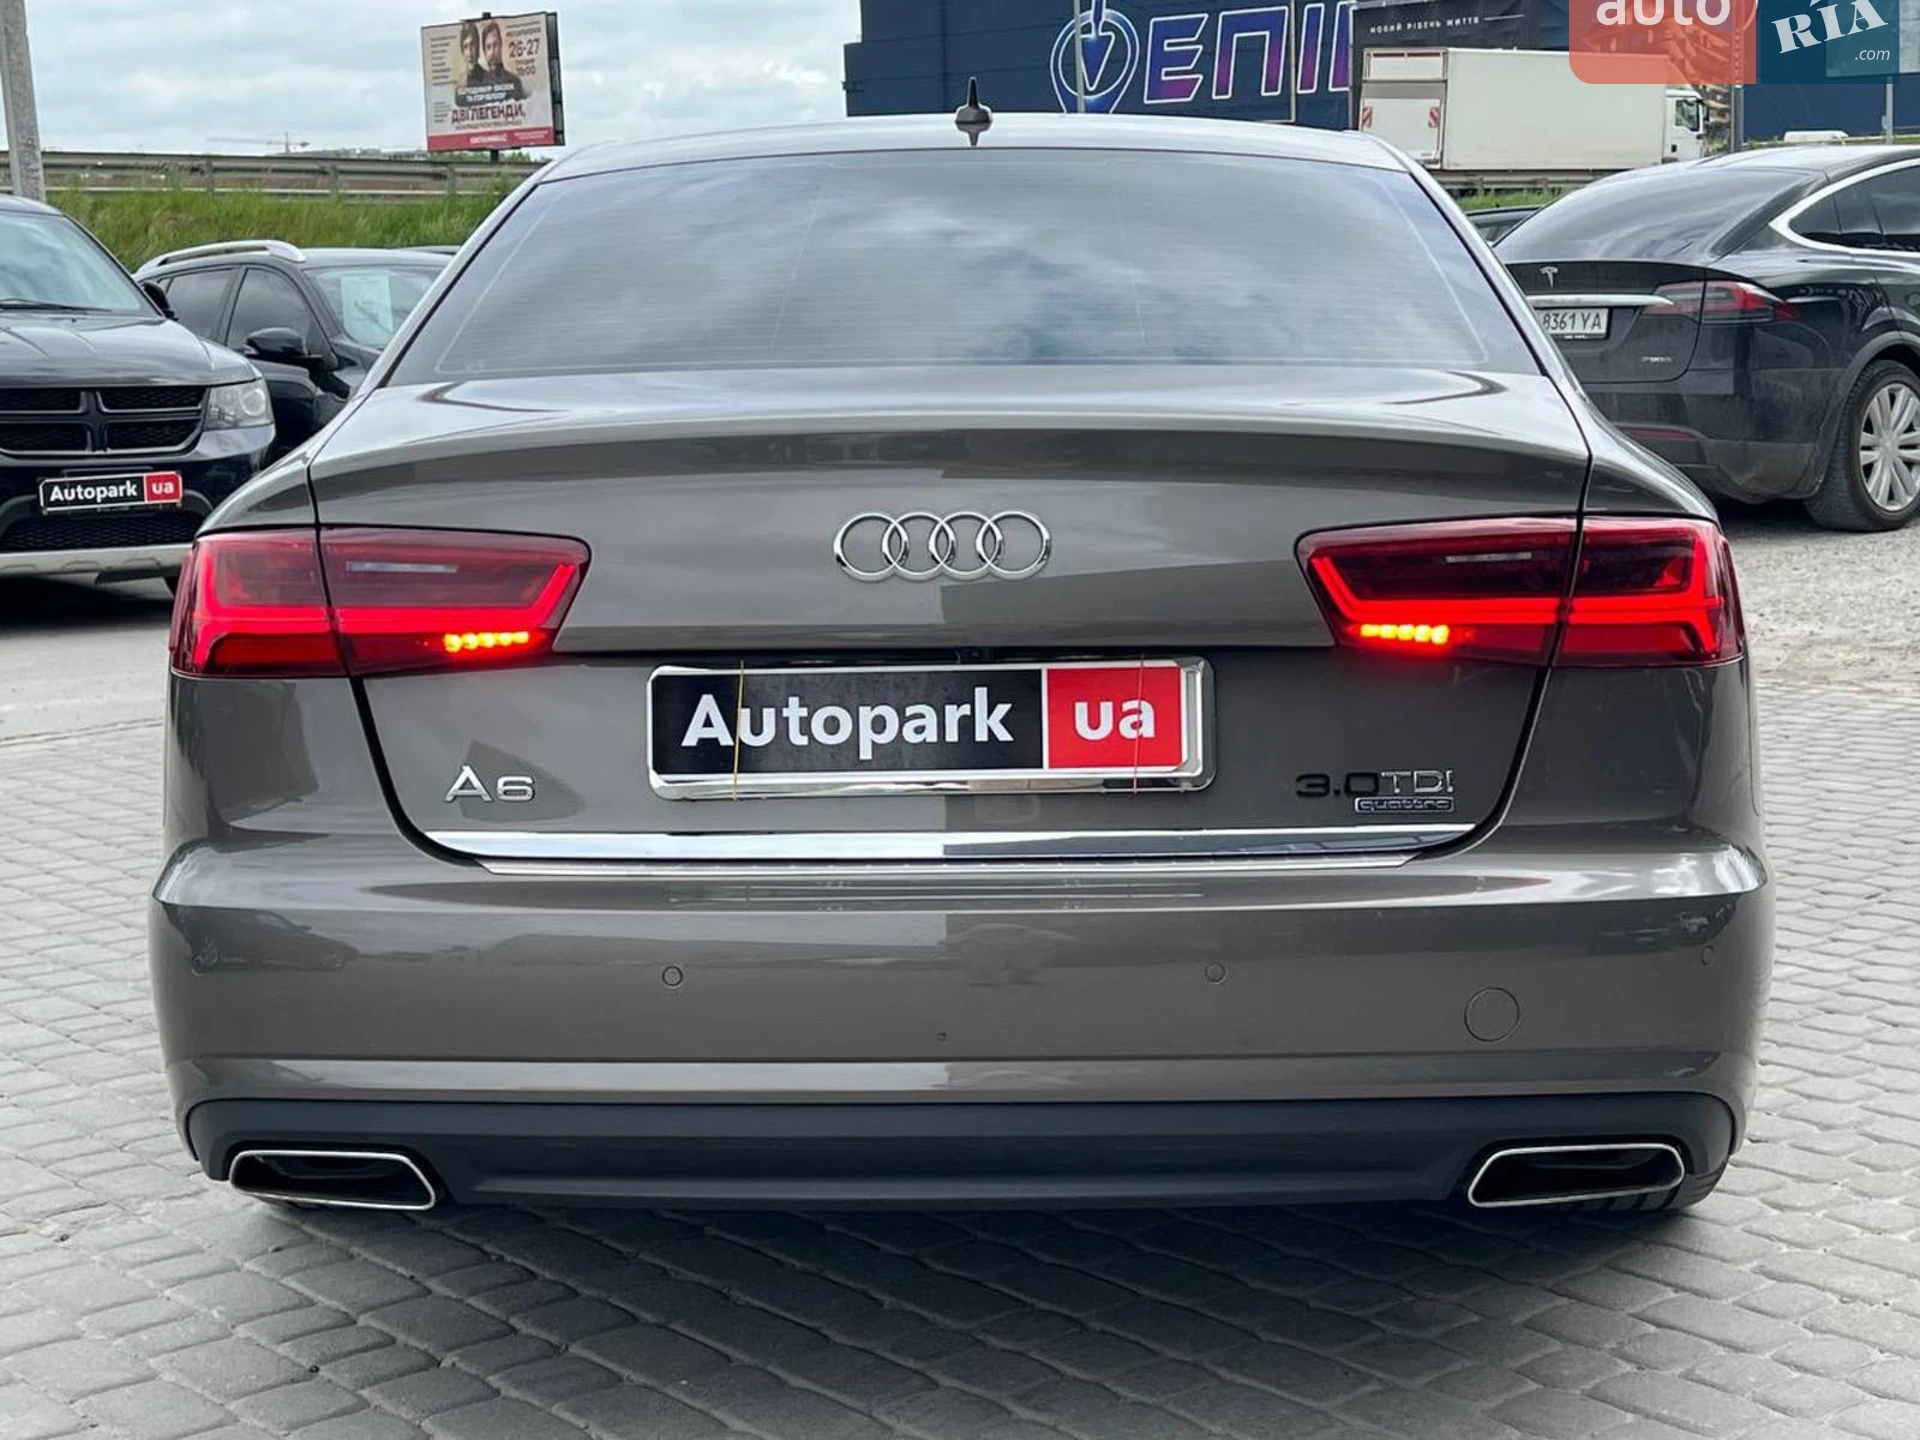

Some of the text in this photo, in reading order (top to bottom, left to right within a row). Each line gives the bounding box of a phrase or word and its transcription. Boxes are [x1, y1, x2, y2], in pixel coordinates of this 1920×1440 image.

[1542, 312, 1577, 330] 8361
[50, 480, 175, 503] Autopark ua
[680, 686, 1156, 760] Autopark ua
[445, 765, 534, 801] A6
[1360, 799, 1450, 811] quattro
